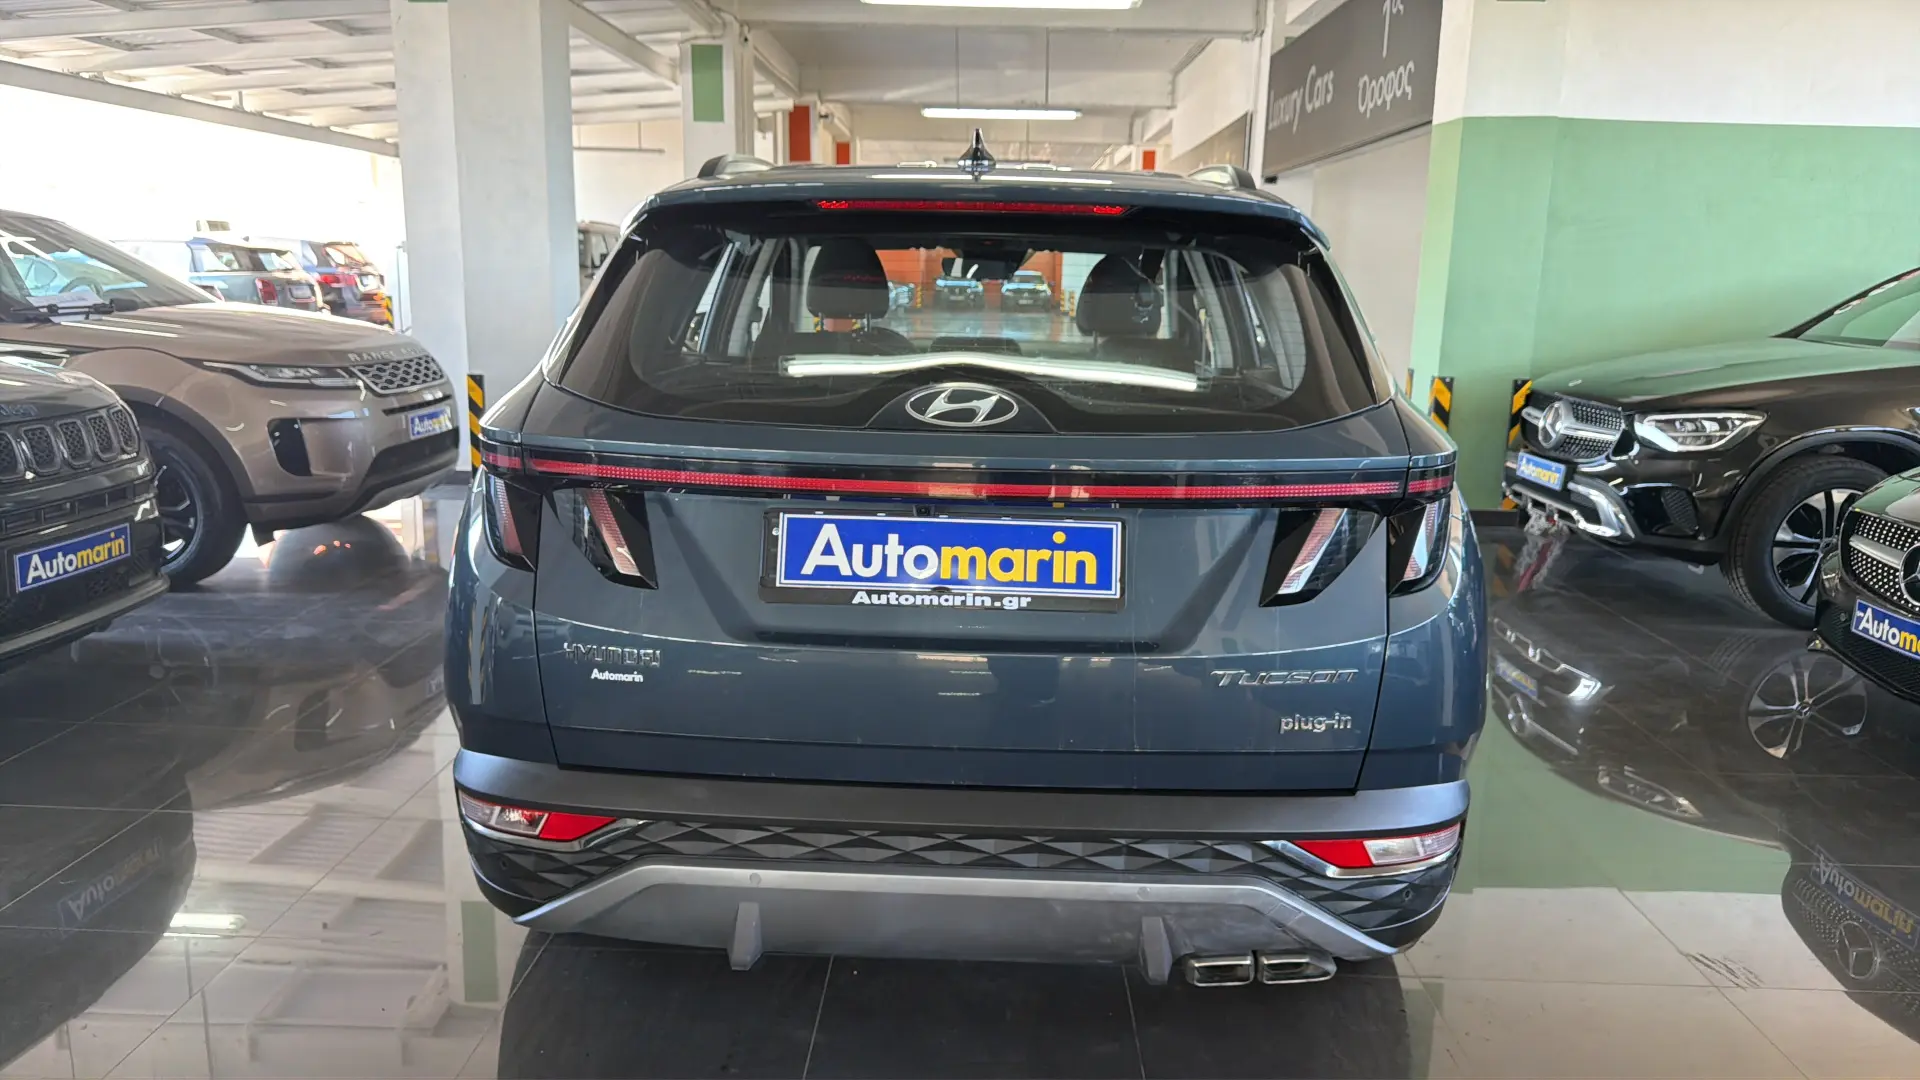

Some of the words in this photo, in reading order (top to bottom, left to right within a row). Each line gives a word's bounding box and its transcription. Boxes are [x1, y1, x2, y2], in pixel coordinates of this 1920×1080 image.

[1268, 88, 1304, 135] Luxury
[1305, 64, 1335, 113] Cars
[27, 531, 125, 584] Automarin
[800, 523, 1098, 585] Automarin
[852, 590, 1032, 610] Automarin.gr
[563, 642, 661, 667] HYUNDAI
[591, 668, 644, 682] Automarin
[1279, 711, 1352, 734] plug-in
